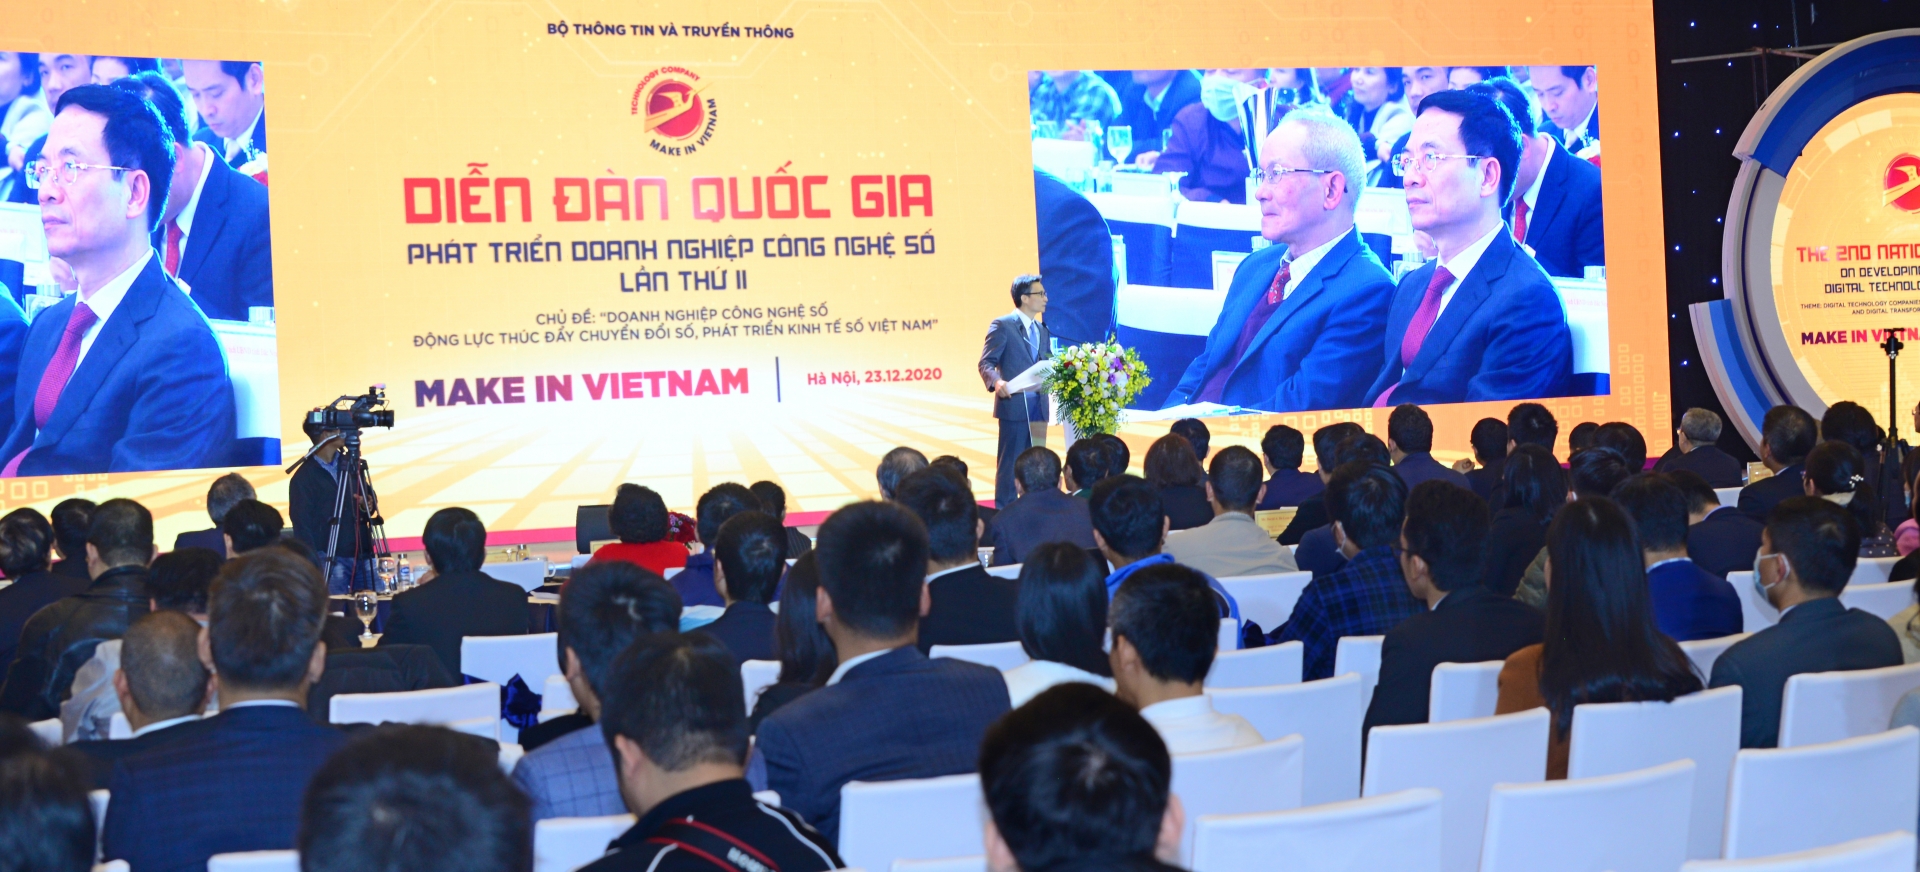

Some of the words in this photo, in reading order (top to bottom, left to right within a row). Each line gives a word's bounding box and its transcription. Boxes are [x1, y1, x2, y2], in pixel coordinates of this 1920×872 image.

[548, 20, 568, 37] BỘ
[573, 21, 626, 36] THÔNG
[631, 24, 654, 36] TIN
[659, 22, 678, 36] VÀ
[744, 24, 794, 38] THÔNG
[631, 69, 659, 115] TECHNOLOGY
[661, 66, 700, 81] COMPANY
[650, 139, 681, 156] MAKE
[684, 144, 696, 154] IN
[696, 98, 717, 146] VIETNAM
[403, 162, 532, 224] DIỄN
[552, 168, 669, 222] ĐÀN
[690, 160, 831, 222] QUỐC
[850, 175, 933, 218] GIA
[408, 238, 477, 264] PHÁT
[488, 234, 562, 263] TRIỂN
[572, 240, 657, 262] DOANH
[667, 234, 754, 262] NGHIỆP
[763, 234, 825, 258] CÔNG
[835, 232, 895, 258] NGHỆ
[905, 228, 935, 255] SỐ
[1796, 246, 1829, 262] THE
[1836, 245, 1871, 261] 2ND
[678, 266, 728, 291] THỨ
[736, 270, 747, 289] II
[1840, 268, 1855, 278] ON
[1860, 266, 1920, 277] DEVELOPIN
[1825, 283, 1864, 294] DIGITAL
[536, 308, 567, 325] CHỦ
[665, 306, 717, 323] NGHIỆP
[722, 305, 763, 320] CÔNG
[768, 304, 805, 320] NGHỆ
[810, 302, 828, 317] SỐ
[414, 332, 459, 349] ĐỘNG
[464, 331, 494, 346] LỰC
[499, 330, 540, 344] THÚC
[545, 327, 574, 343] ĐẨY
[580, 324, 640, 342] CHUYỂN
[645, 323, 670, 340] ĐỔI
[675, 324, 698, 340] SỐ,
[703, 324, 738, 338] PHÁT
[743, 320, 784, 336] TRIỂN
[788, 323, 821, 335] KINH
[825, 319, 841, 334] TẾ
[846, 317, 864, 333] SỐ
[868, 318, 898, 334] VIỆT
[1801, 331, 1847, 345] MAKE
[1851, 330, 1867, 343] IN
[415, 376, 525, 407] MAKE
[535, 374, 573, 402] IN
[582, 368, 749, 400] VIETNAM
[807, 372, 826, 385] Hà
[831, 370, 860, 386] Nội,
[865, 368, 942, 383] 23.12.2020
